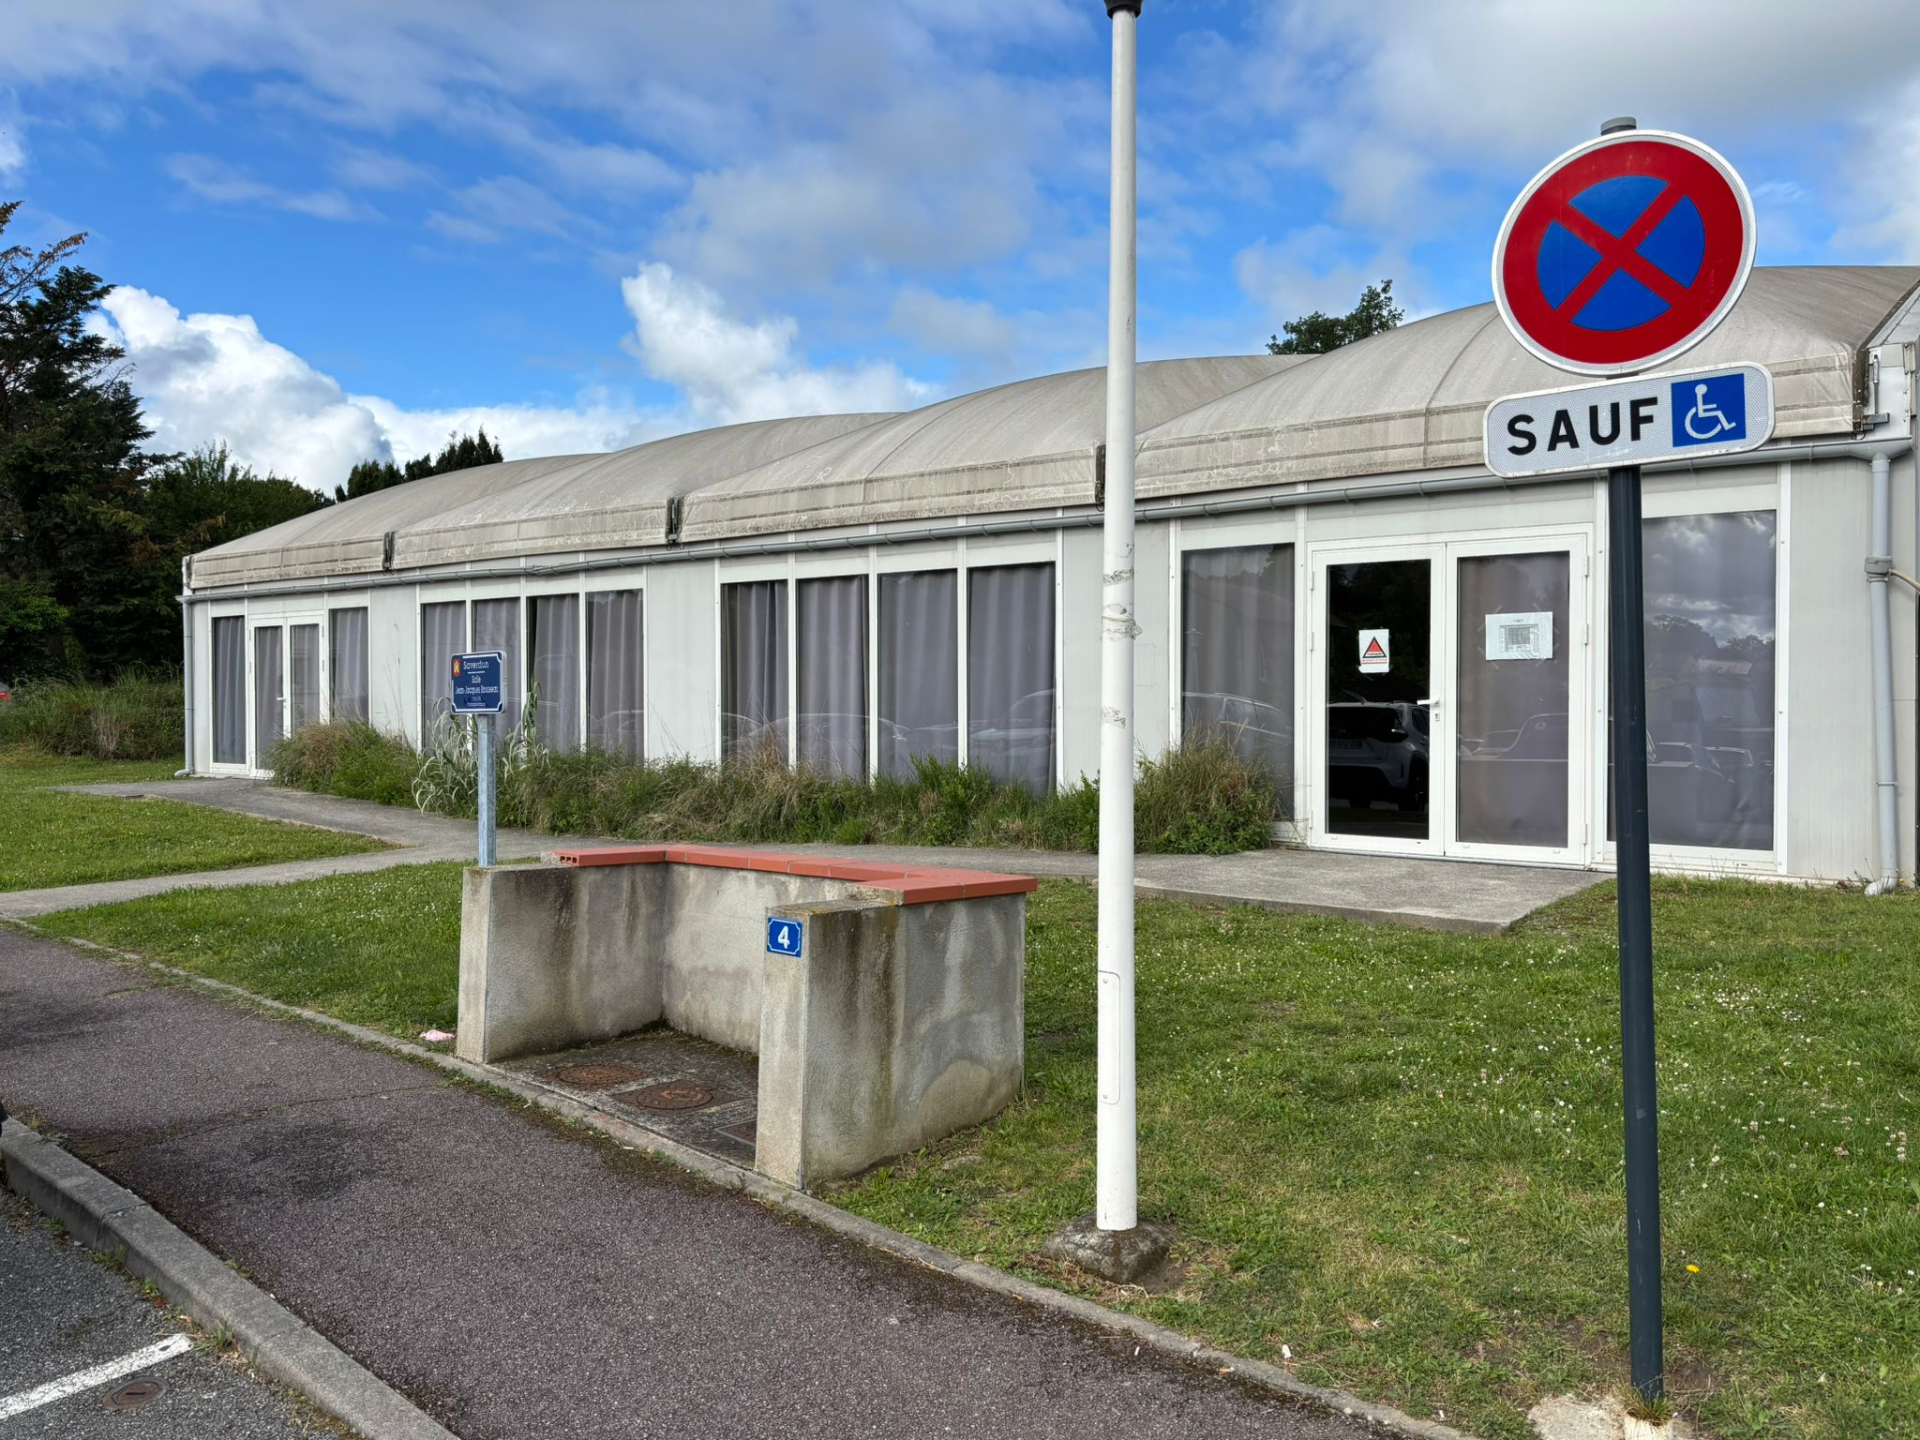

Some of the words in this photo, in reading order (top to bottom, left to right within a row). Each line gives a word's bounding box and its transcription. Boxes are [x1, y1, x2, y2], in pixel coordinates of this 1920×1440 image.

[1507, 396, 1658, 456] SAUF
[463, 660, 490, 670] Saverdun
[777, 925, 791, 950] 4
